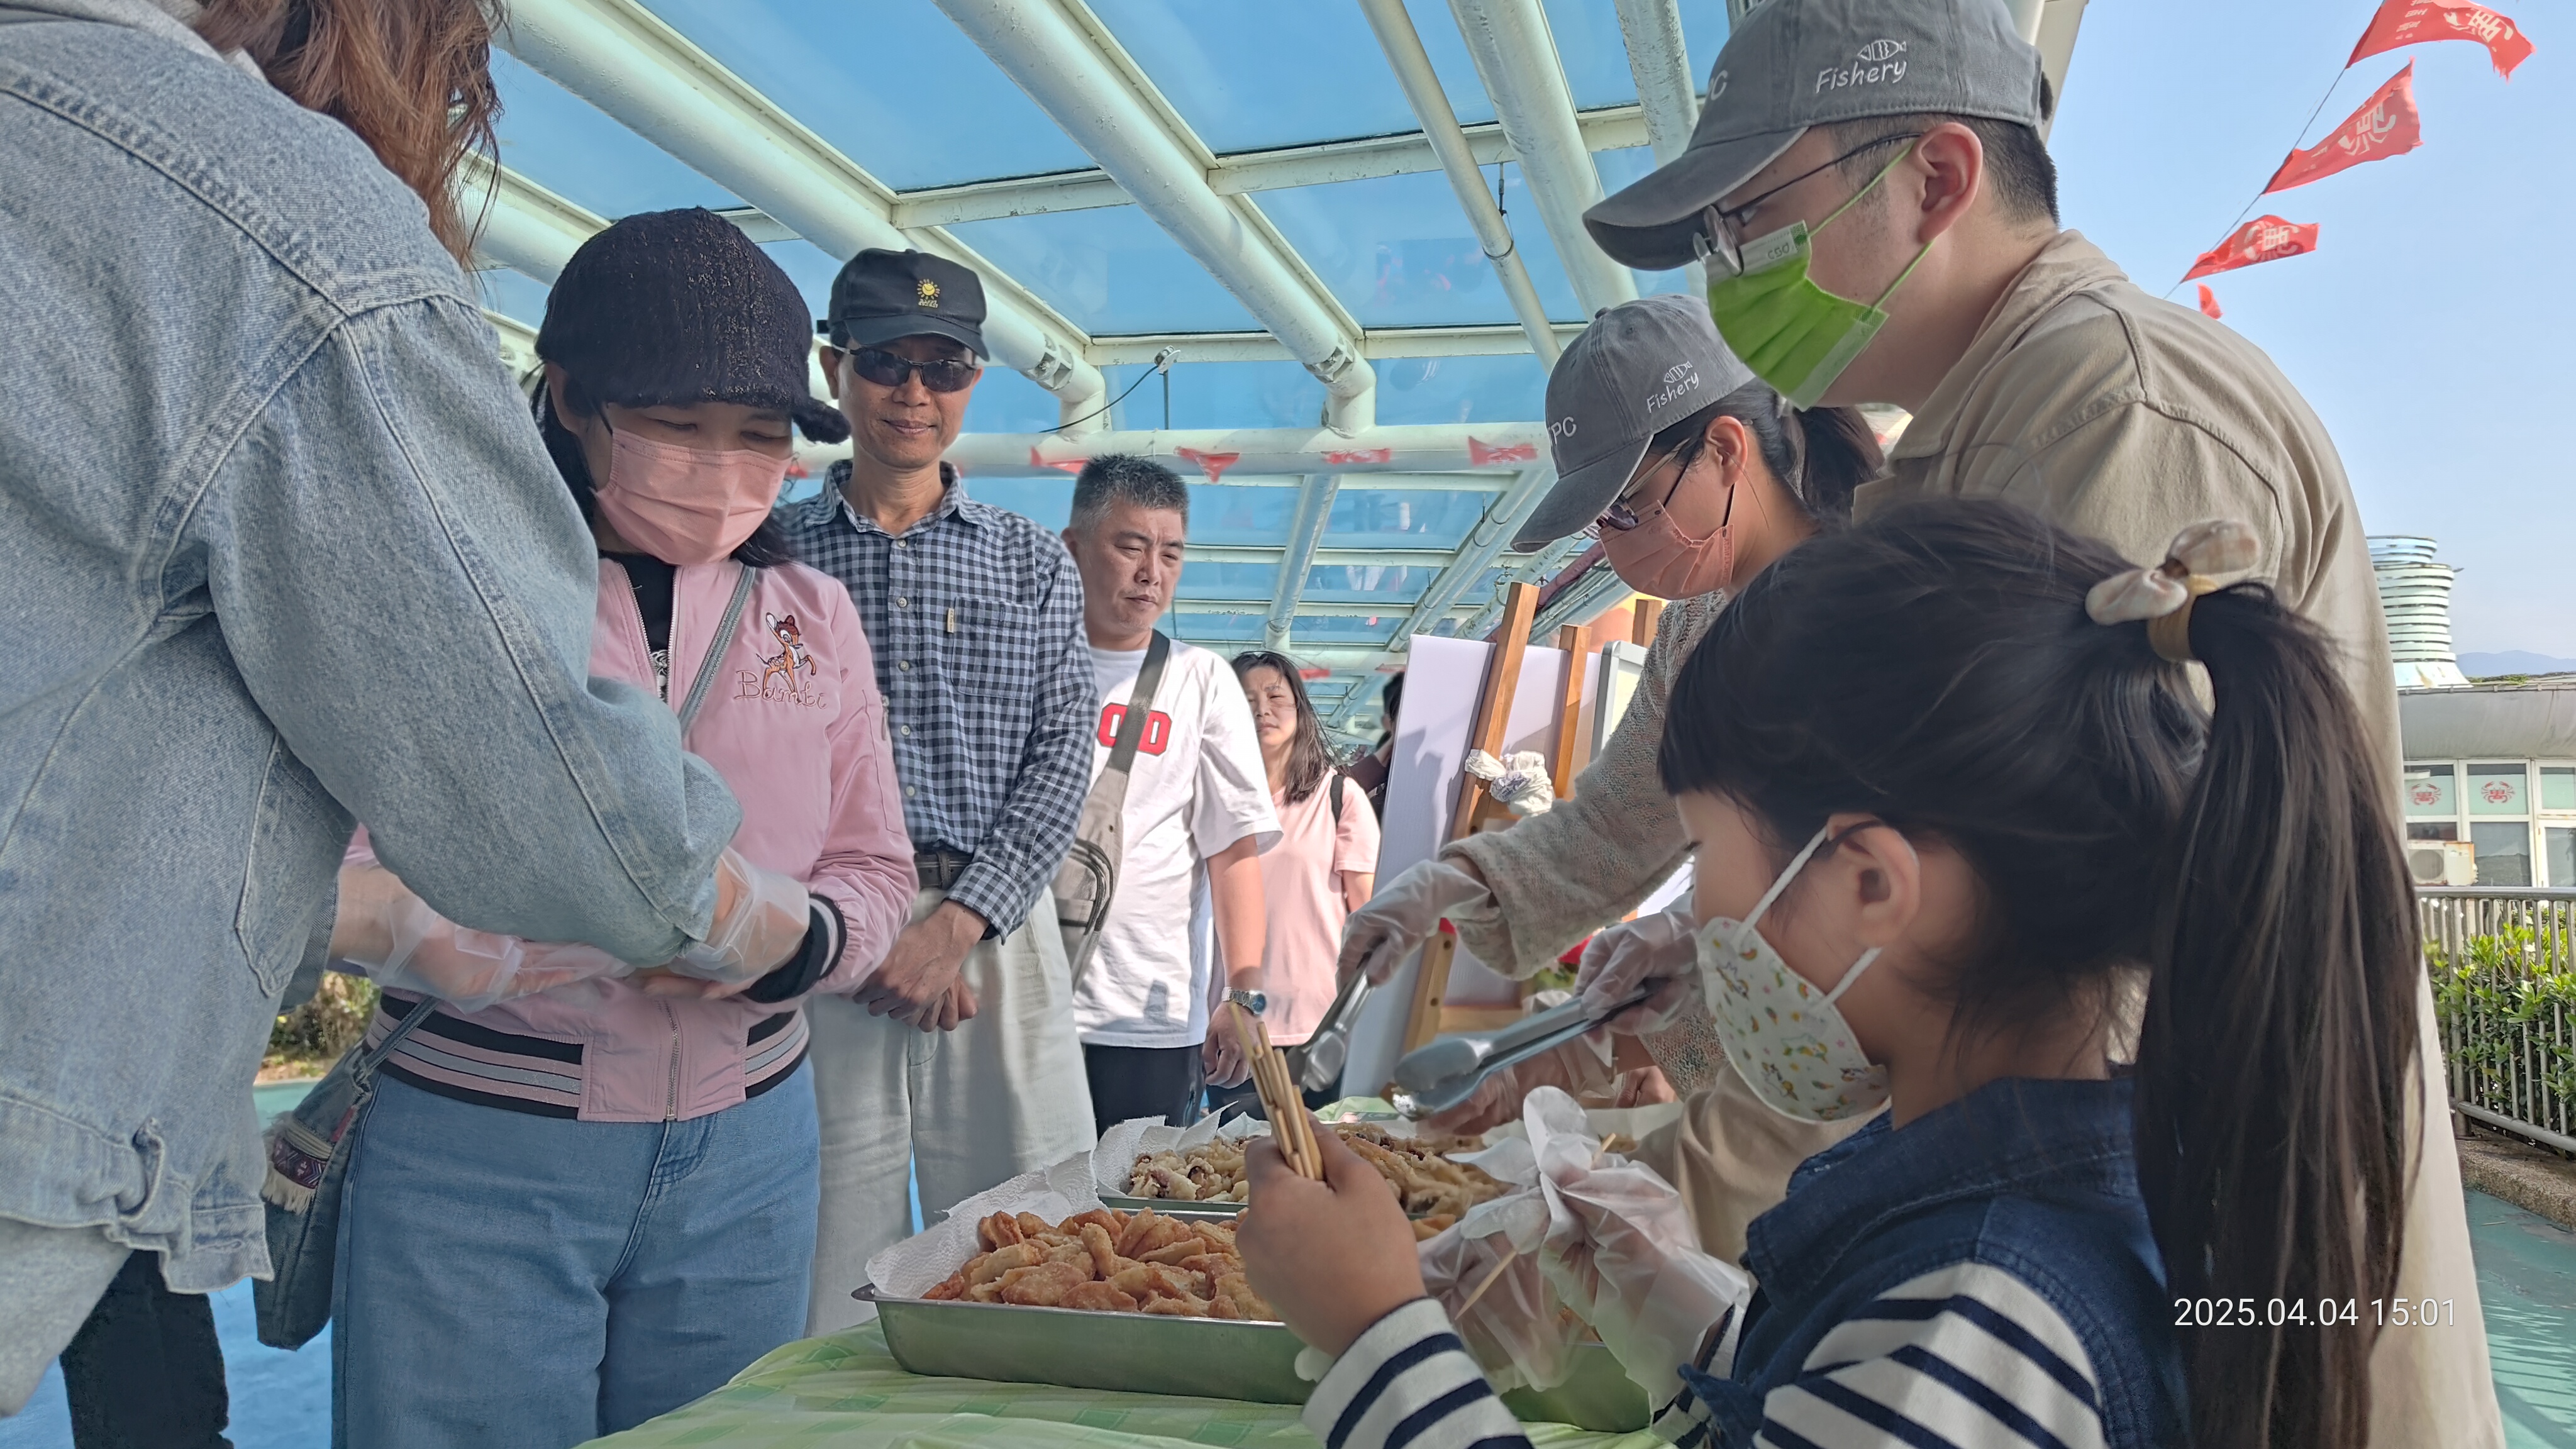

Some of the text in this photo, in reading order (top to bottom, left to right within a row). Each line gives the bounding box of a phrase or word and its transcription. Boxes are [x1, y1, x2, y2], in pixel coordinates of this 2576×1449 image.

[1816, 59, 1907, 94] Fishery
[1646, 371, 1699, 414] Fishery
[733, 670, 828, 709] Bambi
